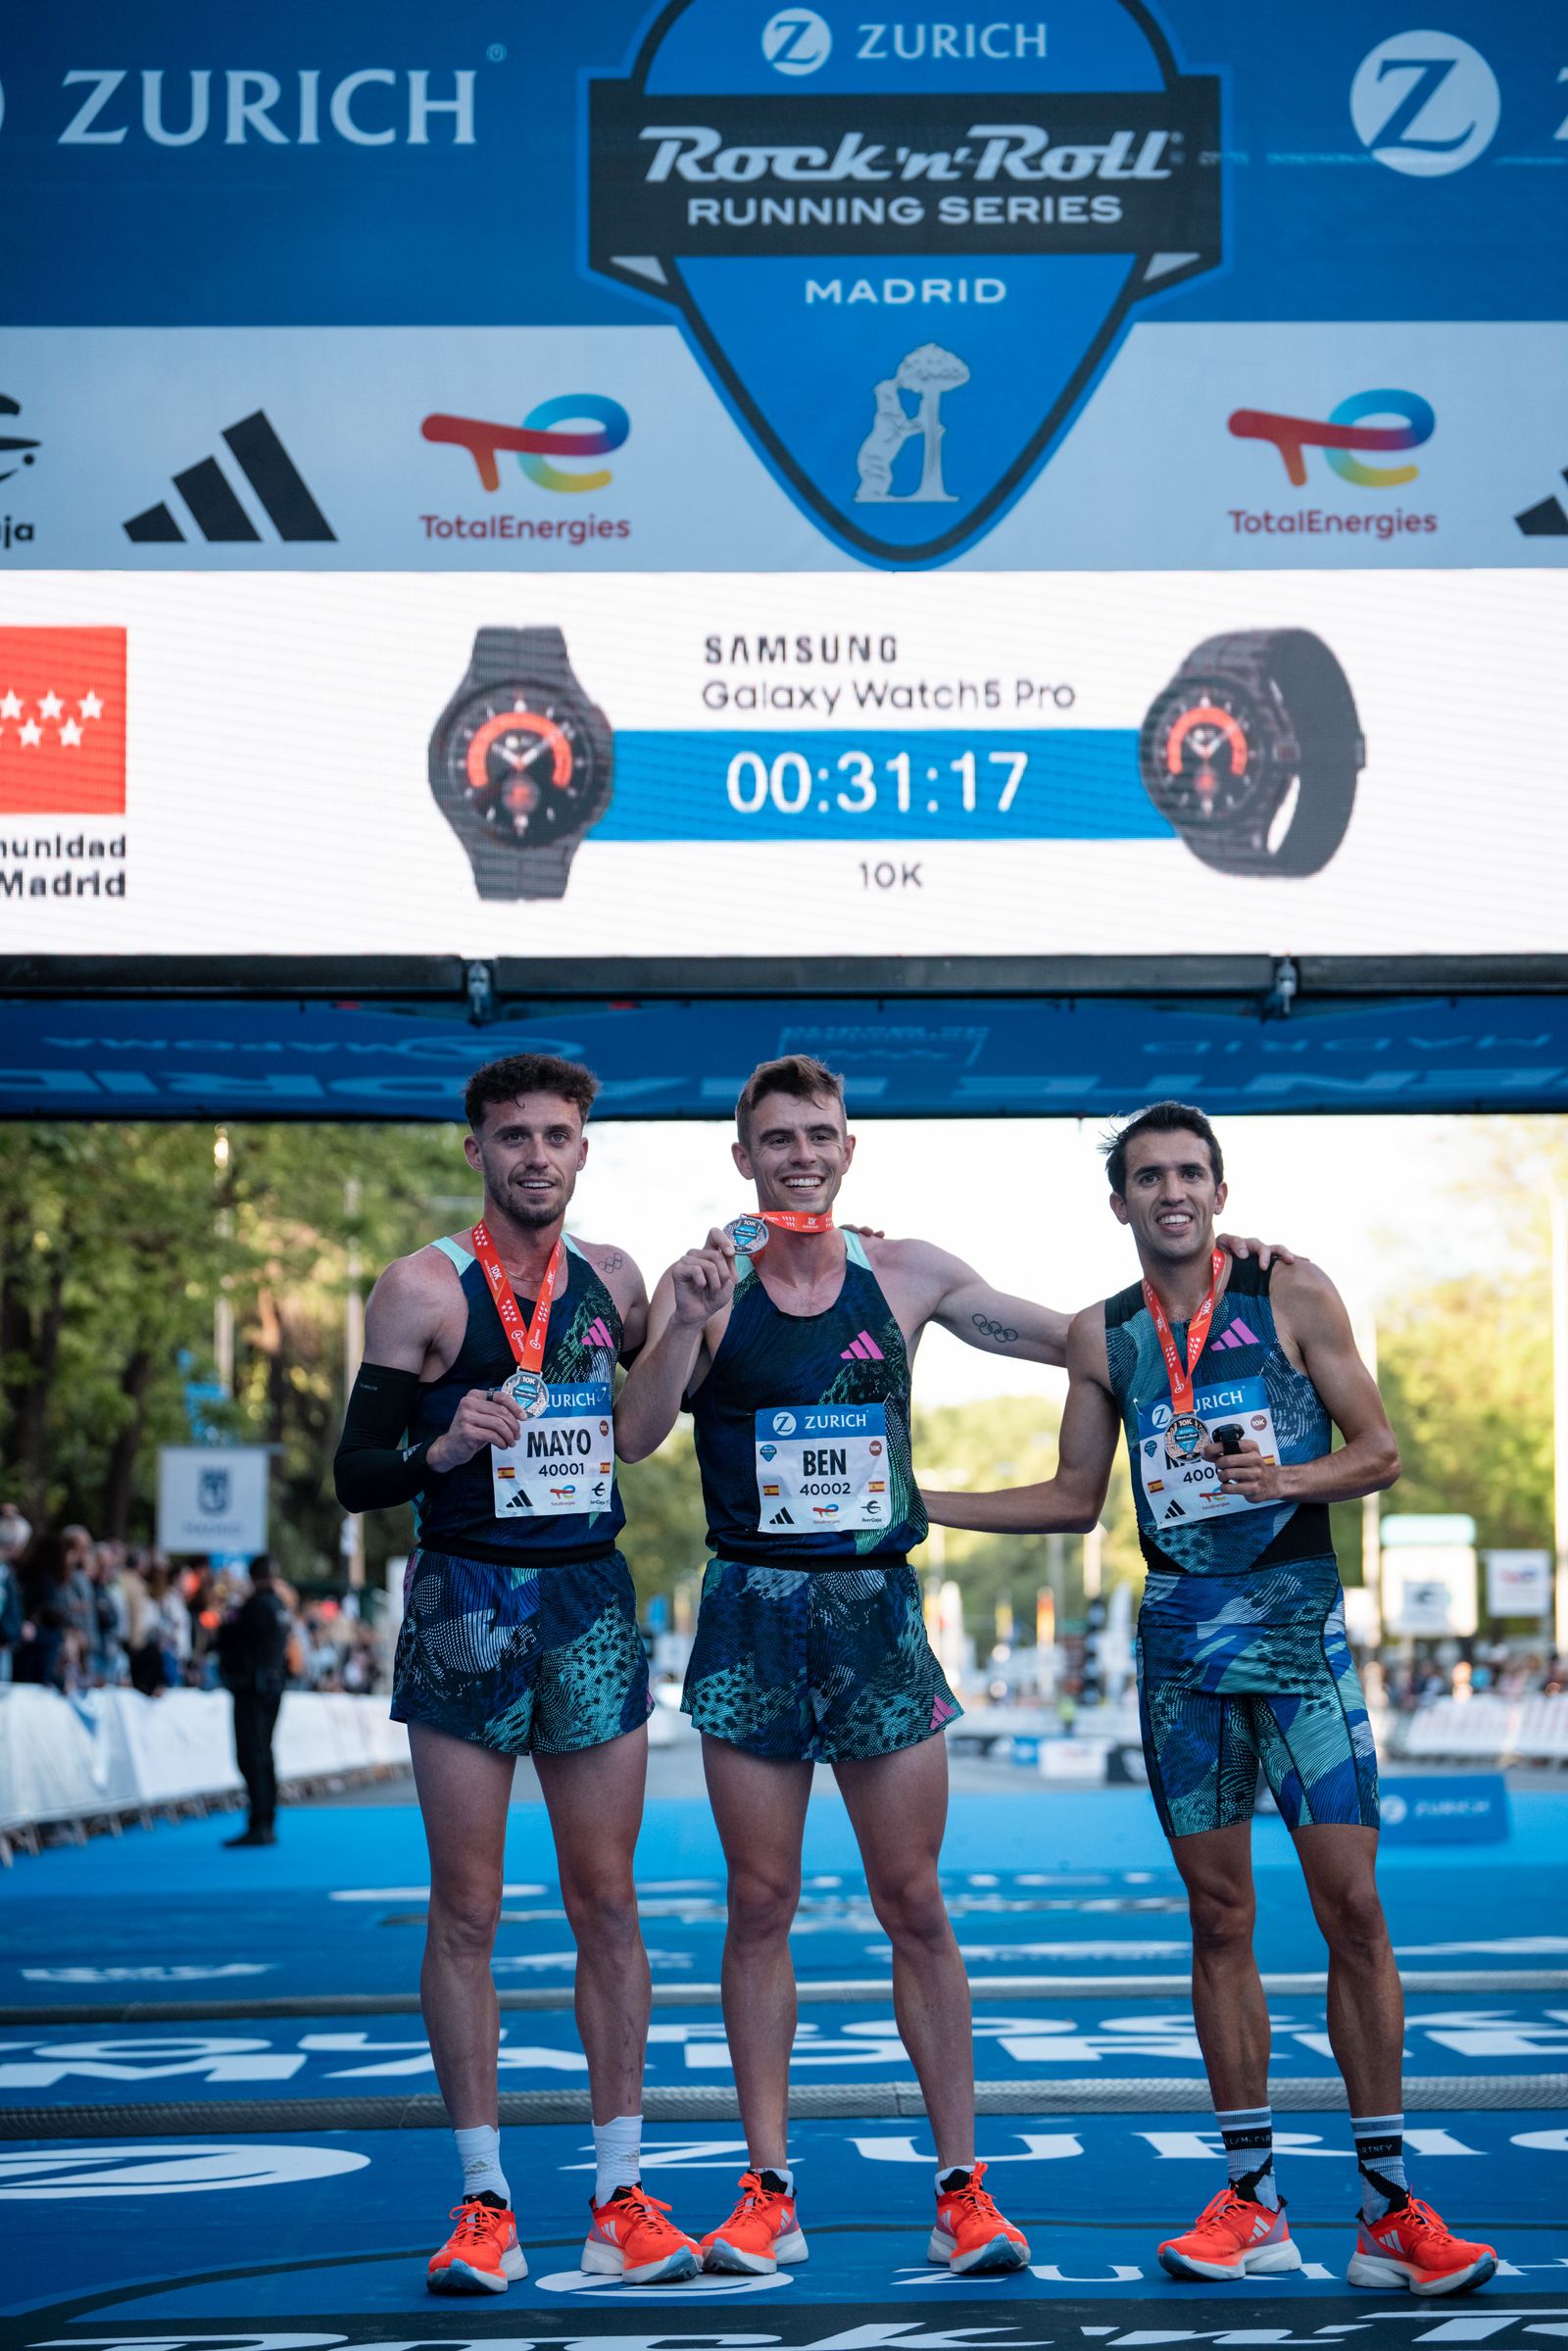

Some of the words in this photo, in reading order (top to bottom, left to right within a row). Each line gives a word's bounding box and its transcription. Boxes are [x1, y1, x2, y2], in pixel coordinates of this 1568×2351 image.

[856, 23, 1049, 60] ZURICH
[57, 69, 477, 146] ZURICH
[688, 197, 925, 225] RUNNING
[938, 196, 1123, 224] SERIES
[806, 278, 1007, 305] MADRID
[0, 515, 35, 550] ja
[419, 514, 631, 545] TotalEnergies
[1227, 510, 1439, 539] TotalEnergies
[705, 634, 898, 664] SAMSUNG
[702, 679, 841, 716] Galaxy
[1015, 679, 1076, 710] Pro
[726, 751, 1029, 813] 00:31:17
[858, 861, 924, 890] 10K
[490, 1263, 503, 1281] 10K
[546, 1393, 596, 1408] URICH
[1194, 1390, 1244, 1413] URICH
[805, 1413, 867, 1430] ZURICH
[1178, 1418, 1194, 1427] 10K
[1251, 1418, 1265, 1428] 10K
[526, 1428, 592, 1459] MAYO
[538, 1462, 585, 1478] 40001
[803, 1448, 848, 1477] BEN
[1183, 1466, 1219, 1484] 400
[800, 1482, 851, 1496] 40002
